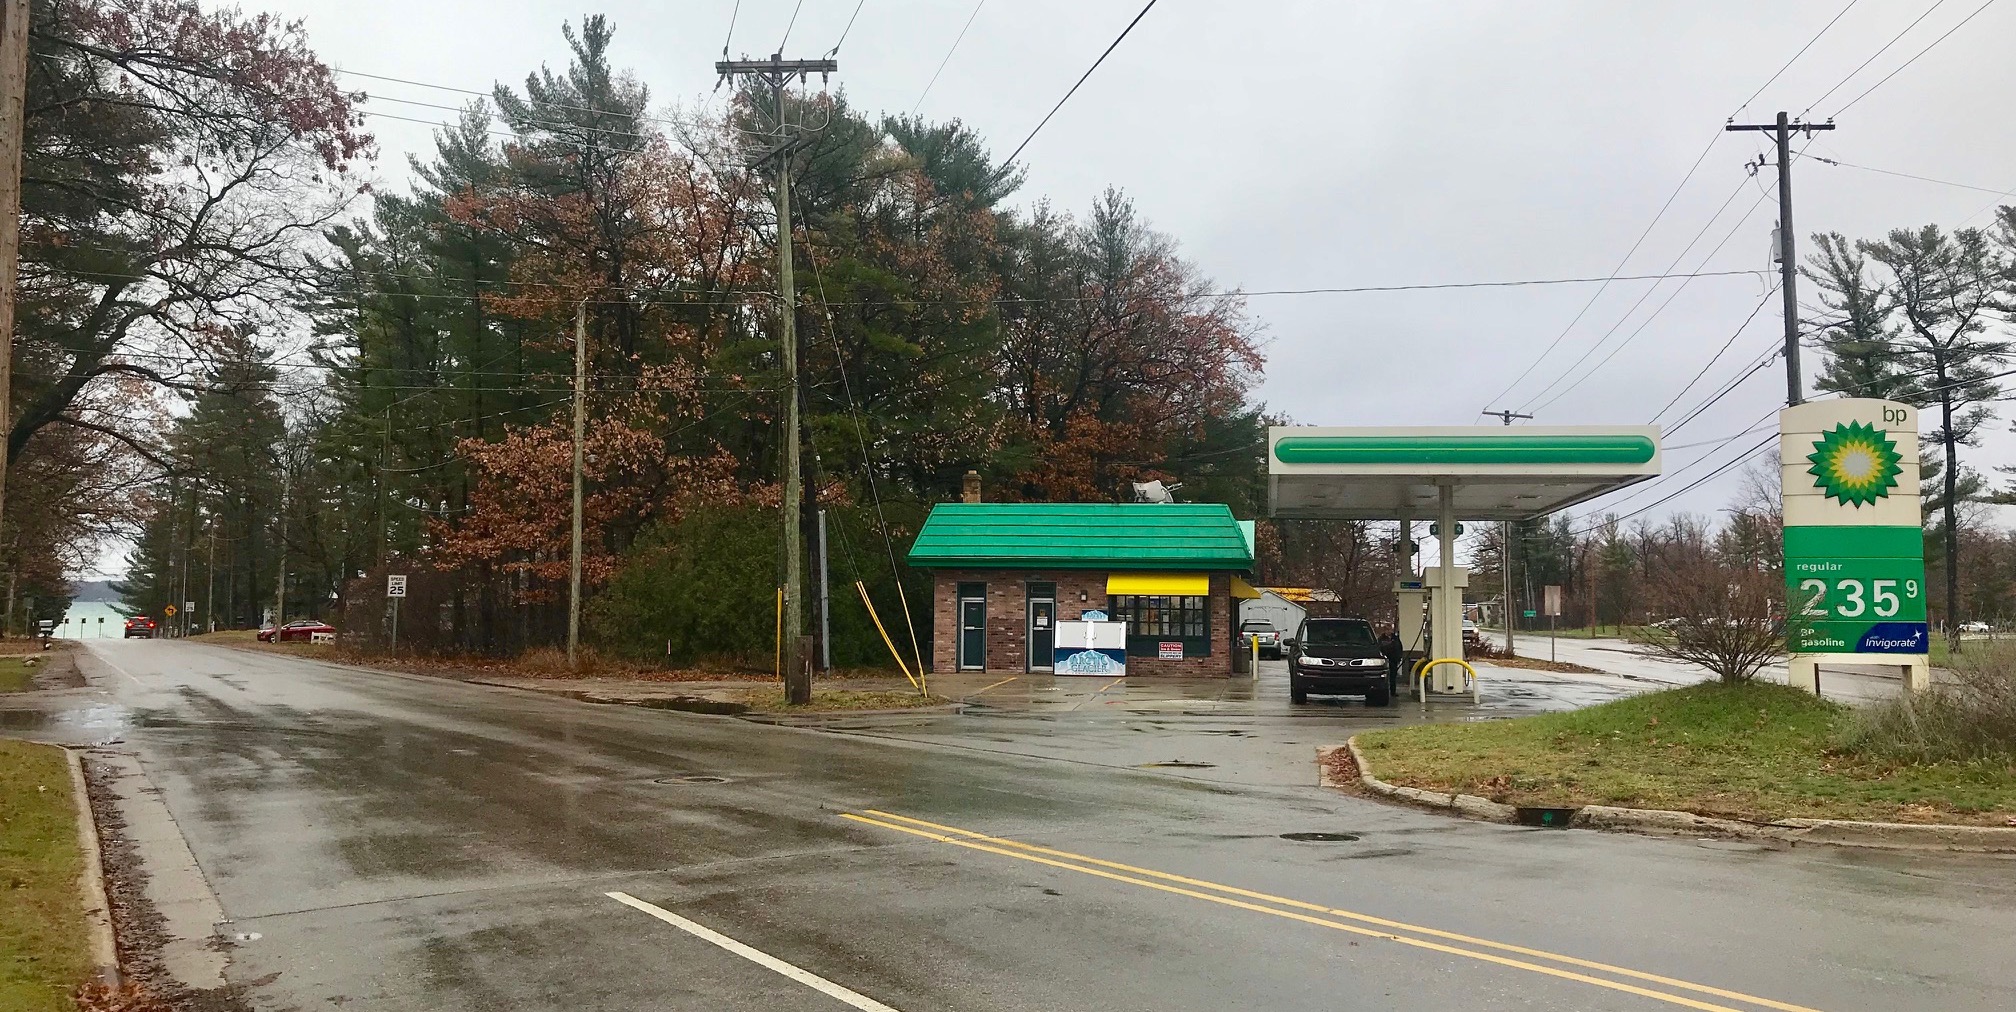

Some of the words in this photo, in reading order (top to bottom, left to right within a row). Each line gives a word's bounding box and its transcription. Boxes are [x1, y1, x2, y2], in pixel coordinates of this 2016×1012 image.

[1883, 405, 1907, 426] bp
[1797, 562, 1843, 572] regular
[390, 586, 403, 594] 25
[1800, 579, 1900, 617] 235
[1905, 579, 1918, 599] 9
[1801, 638, 1845, 648] gasoline
[1865, 638, 1916, 649] Invigorate
[1070, 654, 1108, 665] ARCTIC
[1071, 664, 1108, 673] GLACIER
